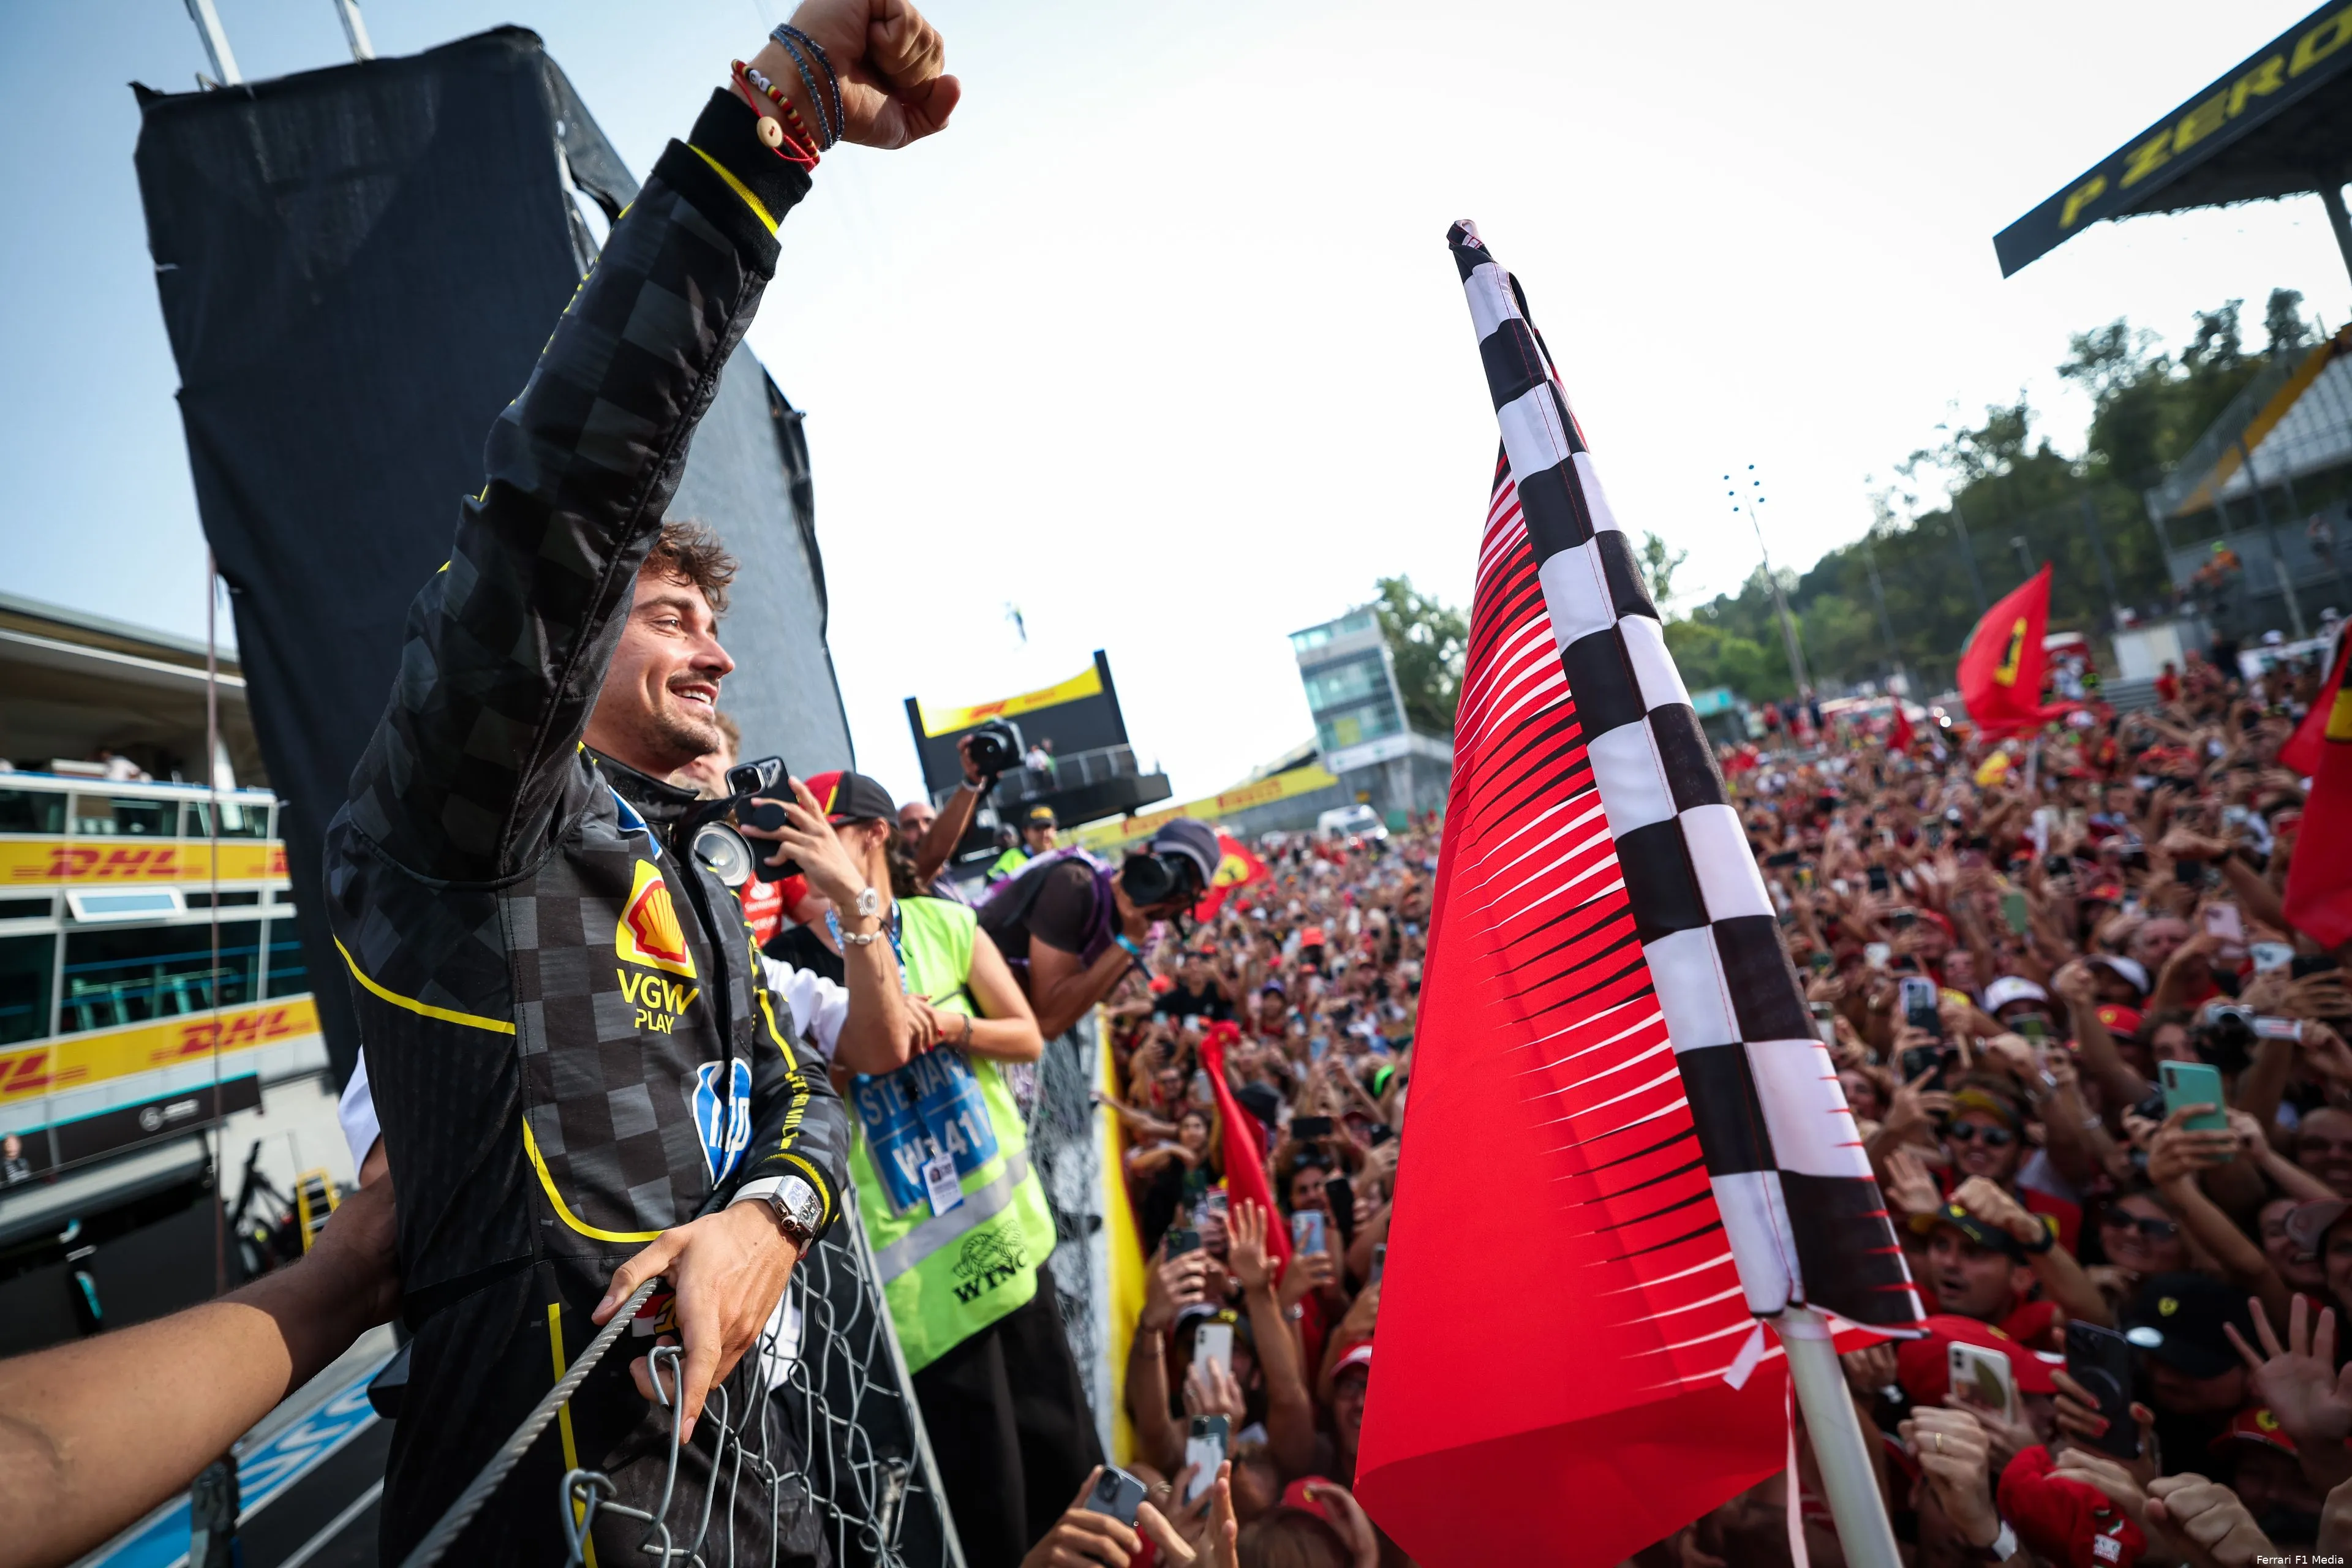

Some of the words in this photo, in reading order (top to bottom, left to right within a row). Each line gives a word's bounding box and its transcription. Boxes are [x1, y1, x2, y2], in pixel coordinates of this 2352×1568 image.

[2058, 174, 2107, 228] P
[47, 849, 178, 877] DHL
[617, 968, 699, 1016] VGW
[179, 1009, 290, 1055] DHL
[635, 1008, 675, 1035] PLAY
